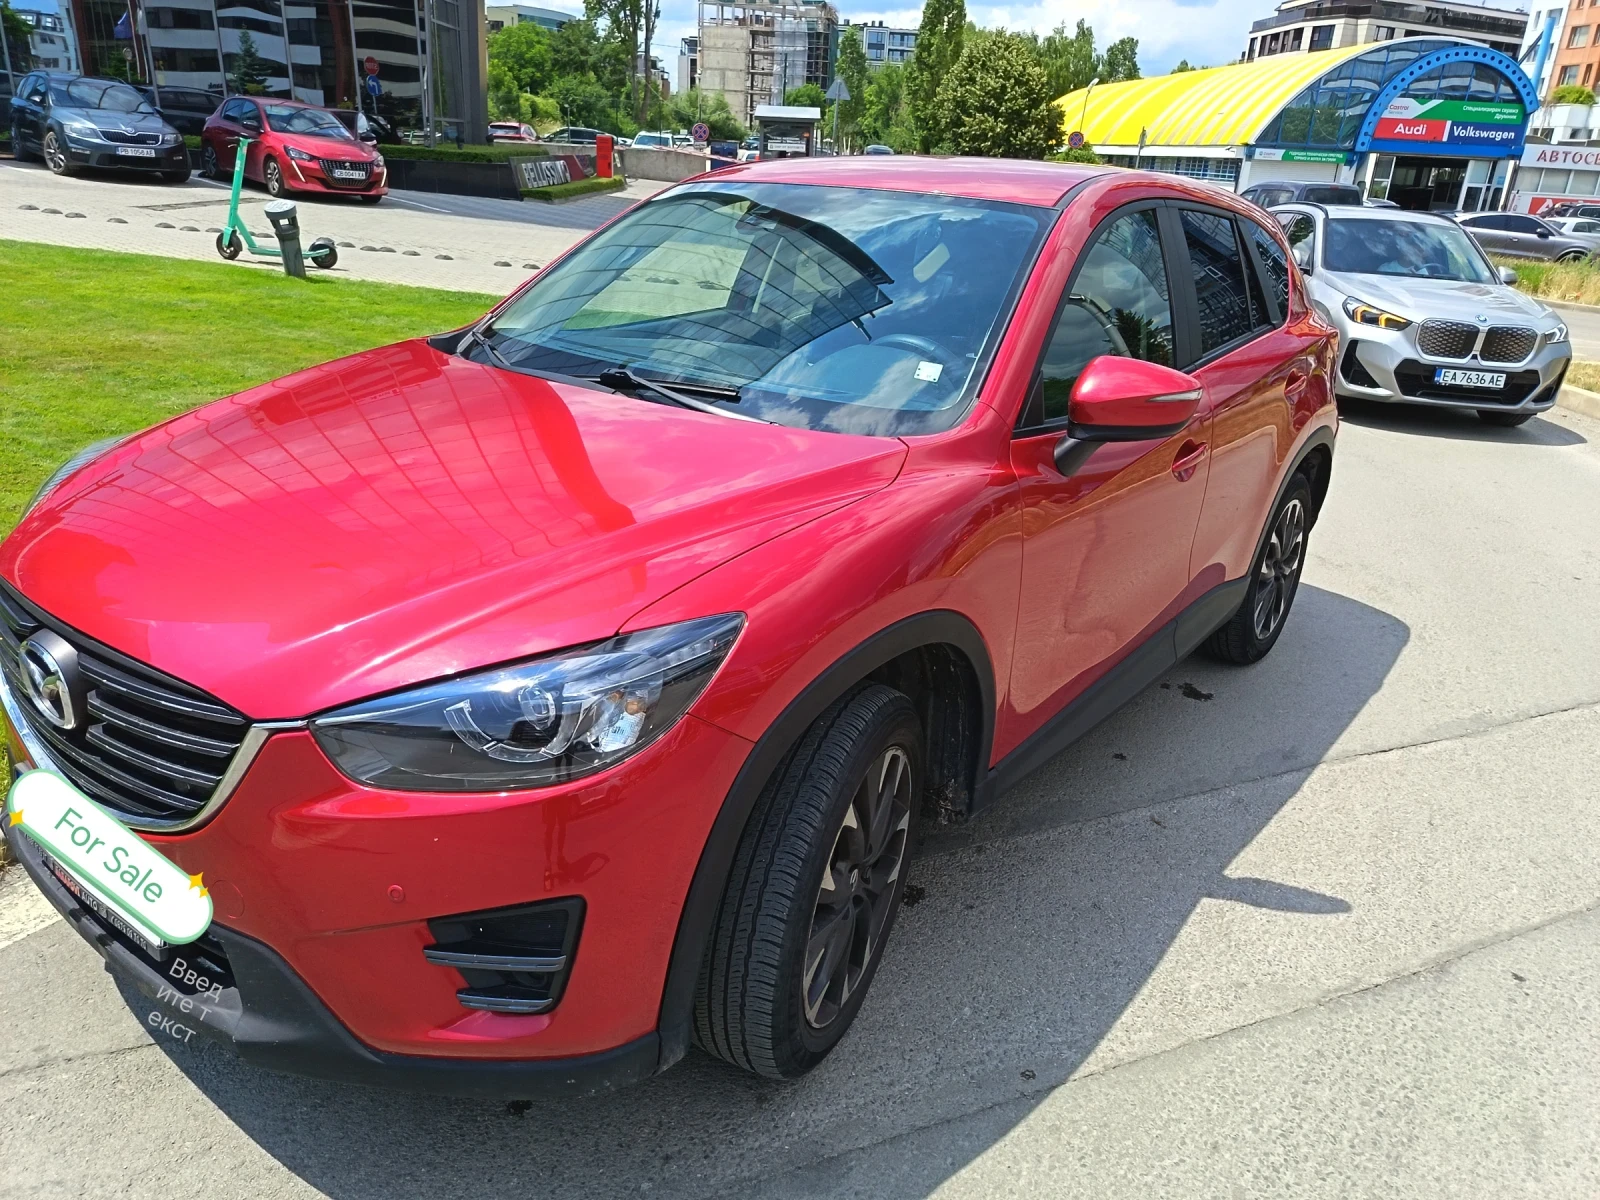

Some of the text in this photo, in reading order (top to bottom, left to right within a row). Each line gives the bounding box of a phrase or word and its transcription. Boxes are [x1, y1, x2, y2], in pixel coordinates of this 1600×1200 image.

[1393, 123, 1427, 135] Audi
[1453, 125, 1515, 141] Volkswagen
[1442, 370, 1504, 387] EA 7636 AE
